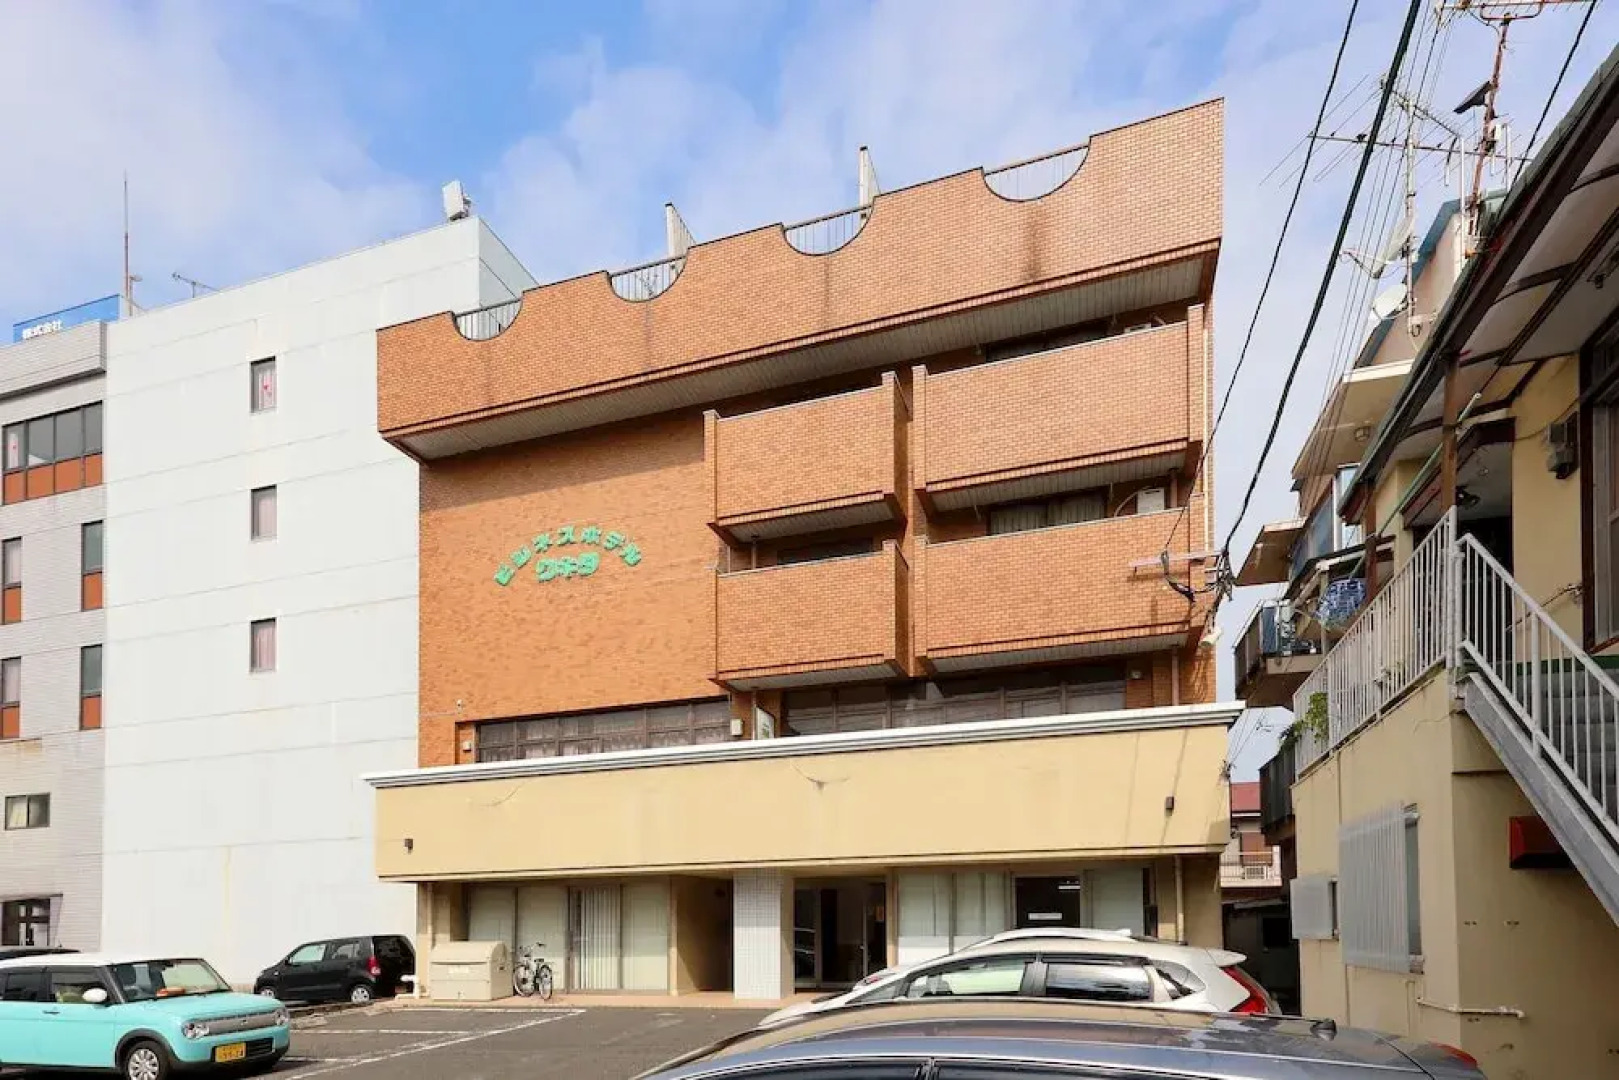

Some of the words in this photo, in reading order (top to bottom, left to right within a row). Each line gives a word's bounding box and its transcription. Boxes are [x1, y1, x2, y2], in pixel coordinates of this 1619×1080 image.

[494, 525, 641, 586] ビジネスホテル
